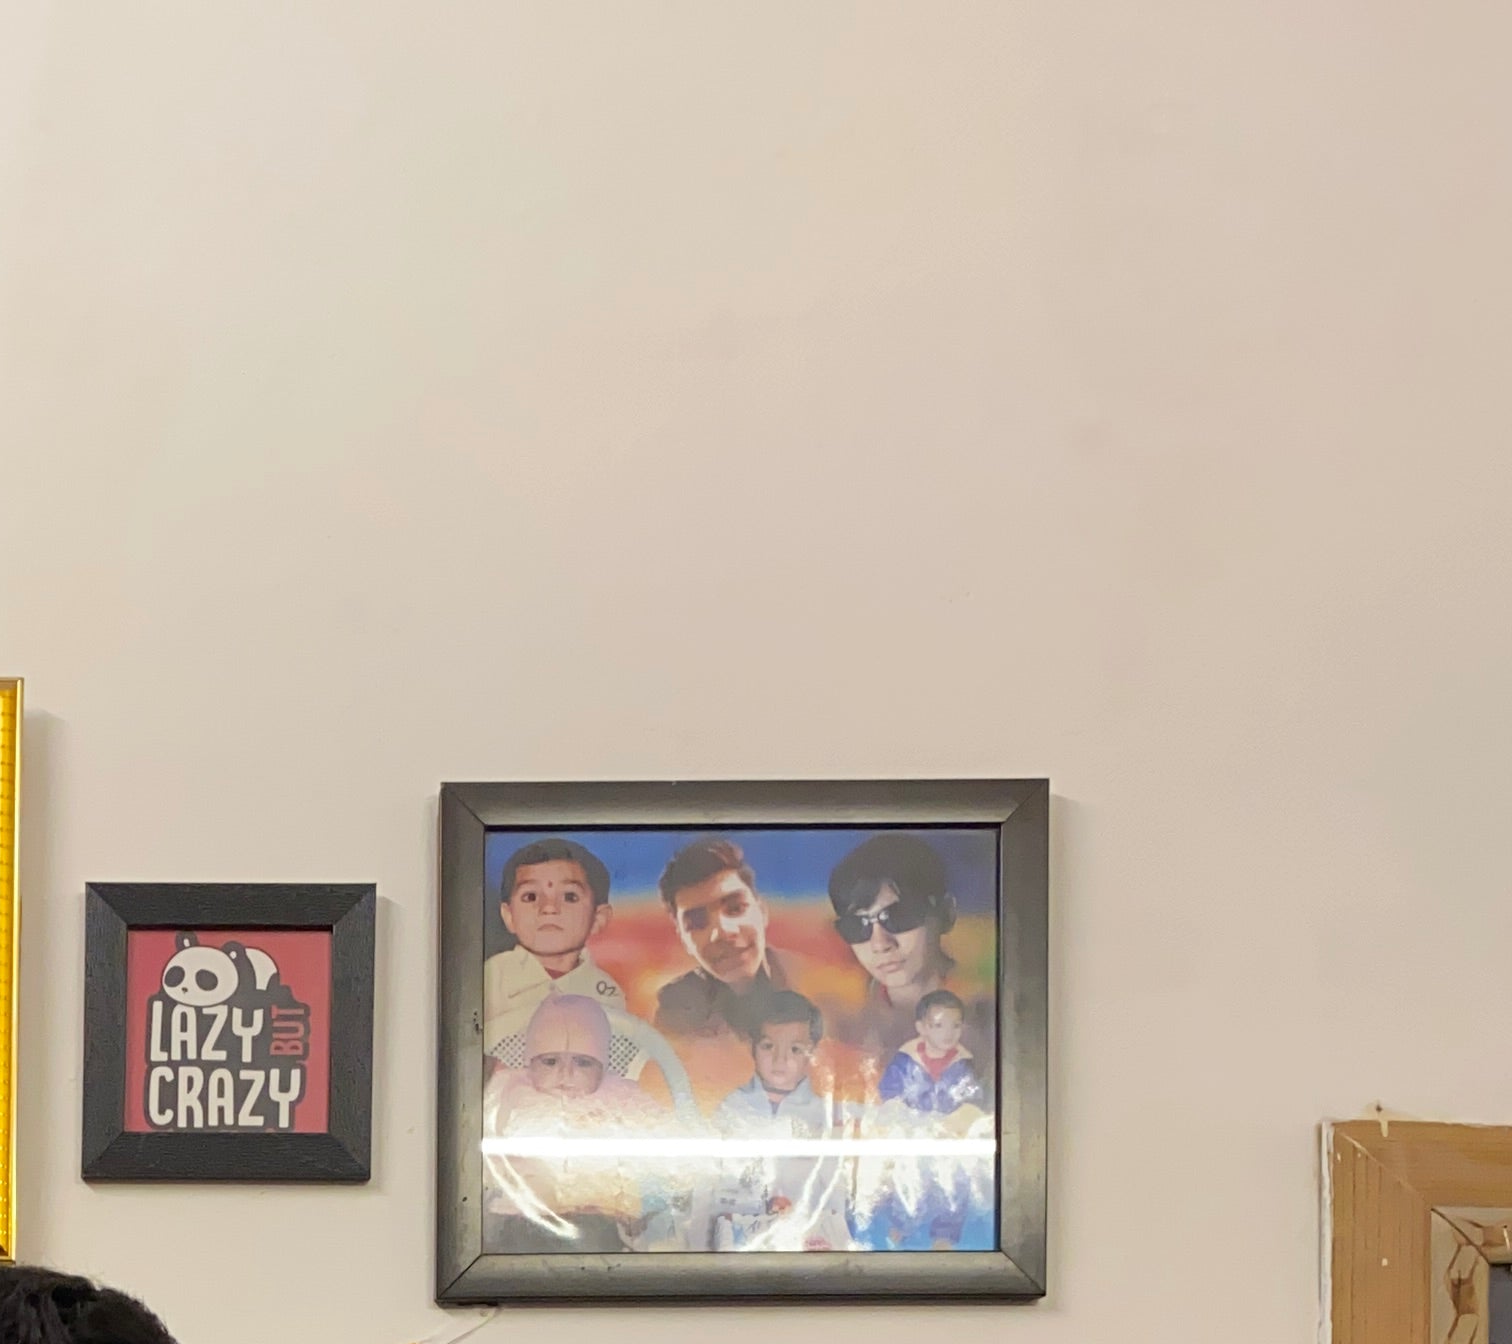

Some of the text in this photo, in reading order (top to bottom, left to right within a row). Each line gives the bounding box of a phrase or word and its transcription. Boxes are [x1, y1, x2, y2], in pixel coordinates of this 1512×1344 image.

[150, 1000, 305, 1063] LAZY BUT
[148, 1066, 301, 1129] CRAZY
